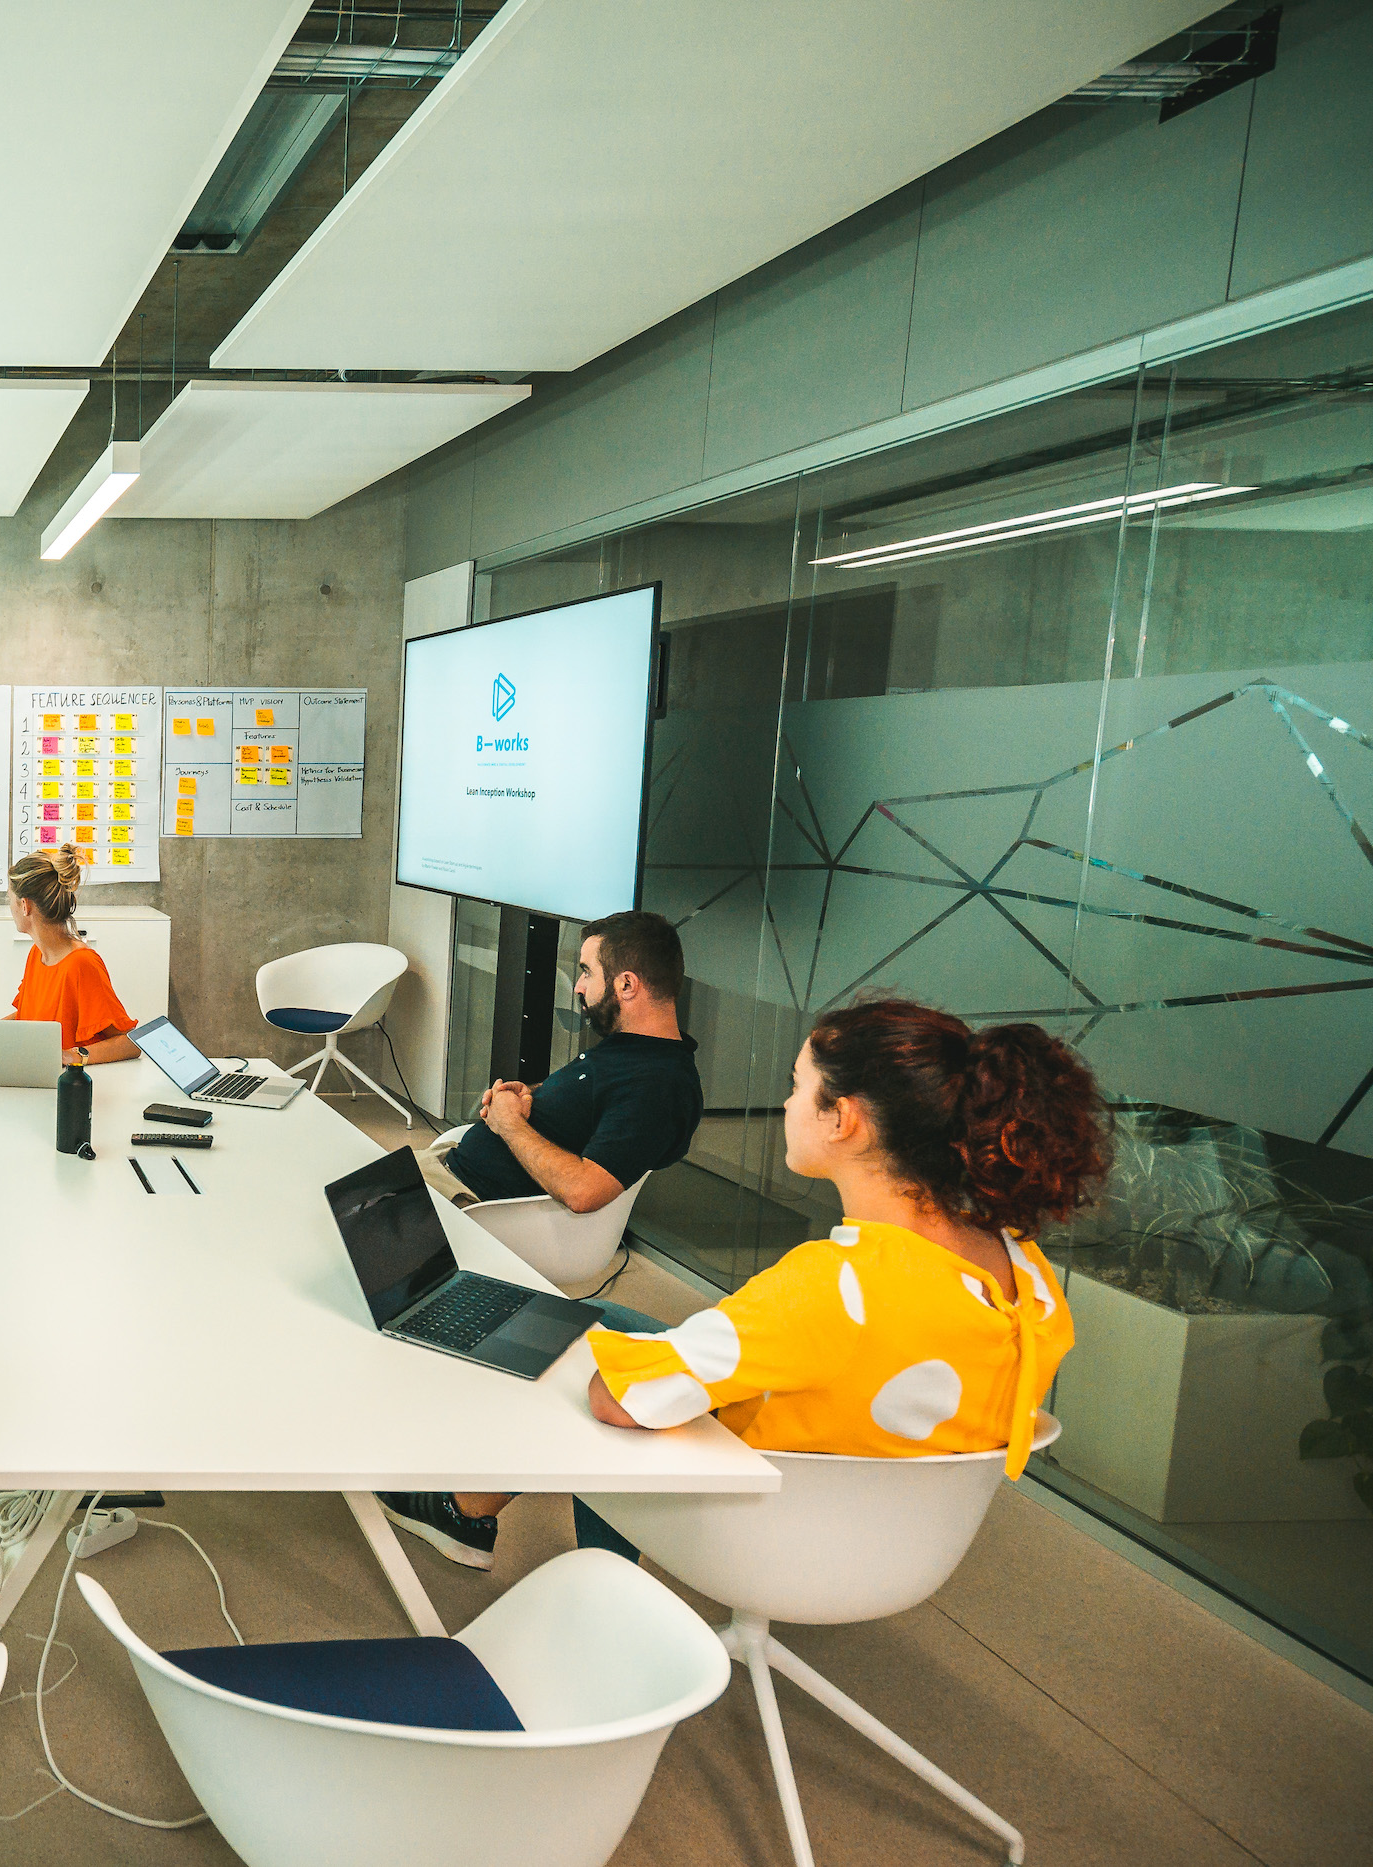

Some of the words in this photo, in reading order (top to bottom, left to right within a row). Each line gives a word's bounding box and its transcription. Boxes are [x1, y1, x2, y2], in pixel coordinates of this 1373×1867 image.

[31, 692, 86, 708] FEATURE
[90, 692, 157, 706] SEQUENCER
[239, 697, 254, 705] MVP
[303, 696, 332, 706] Outcome
[244, 731, 277, 740] Features
[21, 740, 30, 756] 2
[20, 762, 30, 778] 3
[175, 767, 209, 778] Journeys
[19, 782, 27, 800] 4
[466, 787, 479, 796] Lean
[479, 787, 505, 799] Inception
[505, 787, 536, 801] Workshop
[20, 805, 31, 823] 5
[263, 803, 292, 811] Schedule
[19, 829, 28, 845] 6
